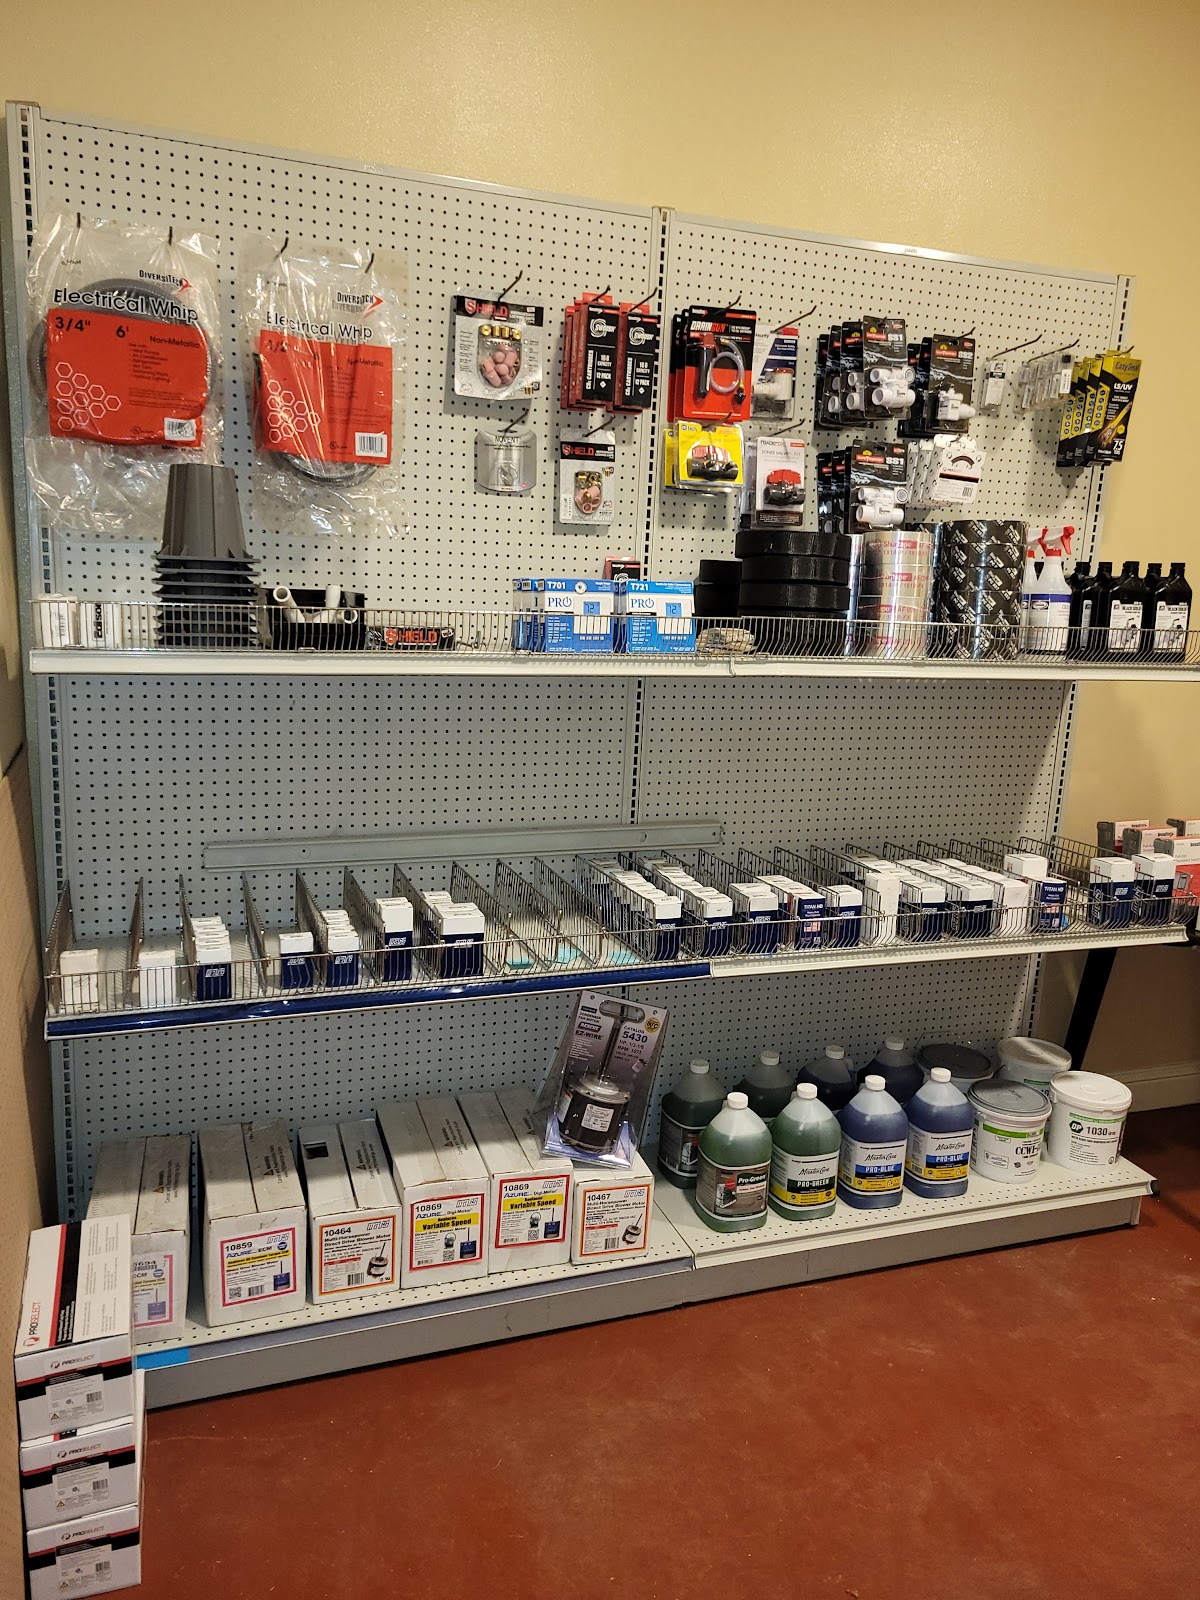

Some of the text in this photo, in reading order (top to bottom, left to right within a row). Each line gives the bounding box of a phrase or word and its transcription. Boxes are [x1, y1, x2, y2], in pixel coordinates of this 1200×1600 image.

[53, 287, 199, 325] Electrical Whip
[465, 298, 508, 317] SHIELD
[55, 316, 91, 332] 3/4"
[266, 311, 373, 340] Electrical Whip
[150, 335, 200, 349] Non-Metallic
[888, 333, 903, 341] SS1
[562, 444, 595, 456] SHIELD
[885, 457, 904, 465] SS1
[547, 581, 566, 590] T701
[630, 582, 649, 591] T721
[548, 597, 572, 607] PRO
[630, 598, 655, 609] PRO
[384, 627, 438, 645] SHIELD
[575, 1030, 602, 1040] EZ-WIRE
[624, 1026, 645, 1034] CATALOG
[622, 1031, 648, 1043] 5430
[1071, 1122, 1082, 1132] DP
[1087, 1126, 1108, 1135] 1030
[936, 1154, 963, 1162] PRO-BLUE
[865, 1165, 894, 1173] PRO-BLUE
[738, 1175, 766, 1183] Pro-Green
[798, 1178, 830, 1187] PRO-GREEN
[504, 1183, 529, 1191] 10869
[587, 1193, 611, 1201] 10467
[415, 1203, 442, 1212] 10869
[510, 1199, 557, 1209] Variable Speed
[423, 1218, 472, 1230] Variable Speed
[324, 1227, 351, 1237] 10464
[225, 1241, 253, 1251] 10859
[226, 1250, 253, 1258] AZURE
[29, 1302, 41, 1335] PROSELECT
[62, 1354, 95, 1366] PROSELECT
[69, 1444, 102, 1455] PROSELECT
[72, 1526, 104, 1537] PROSELECT
